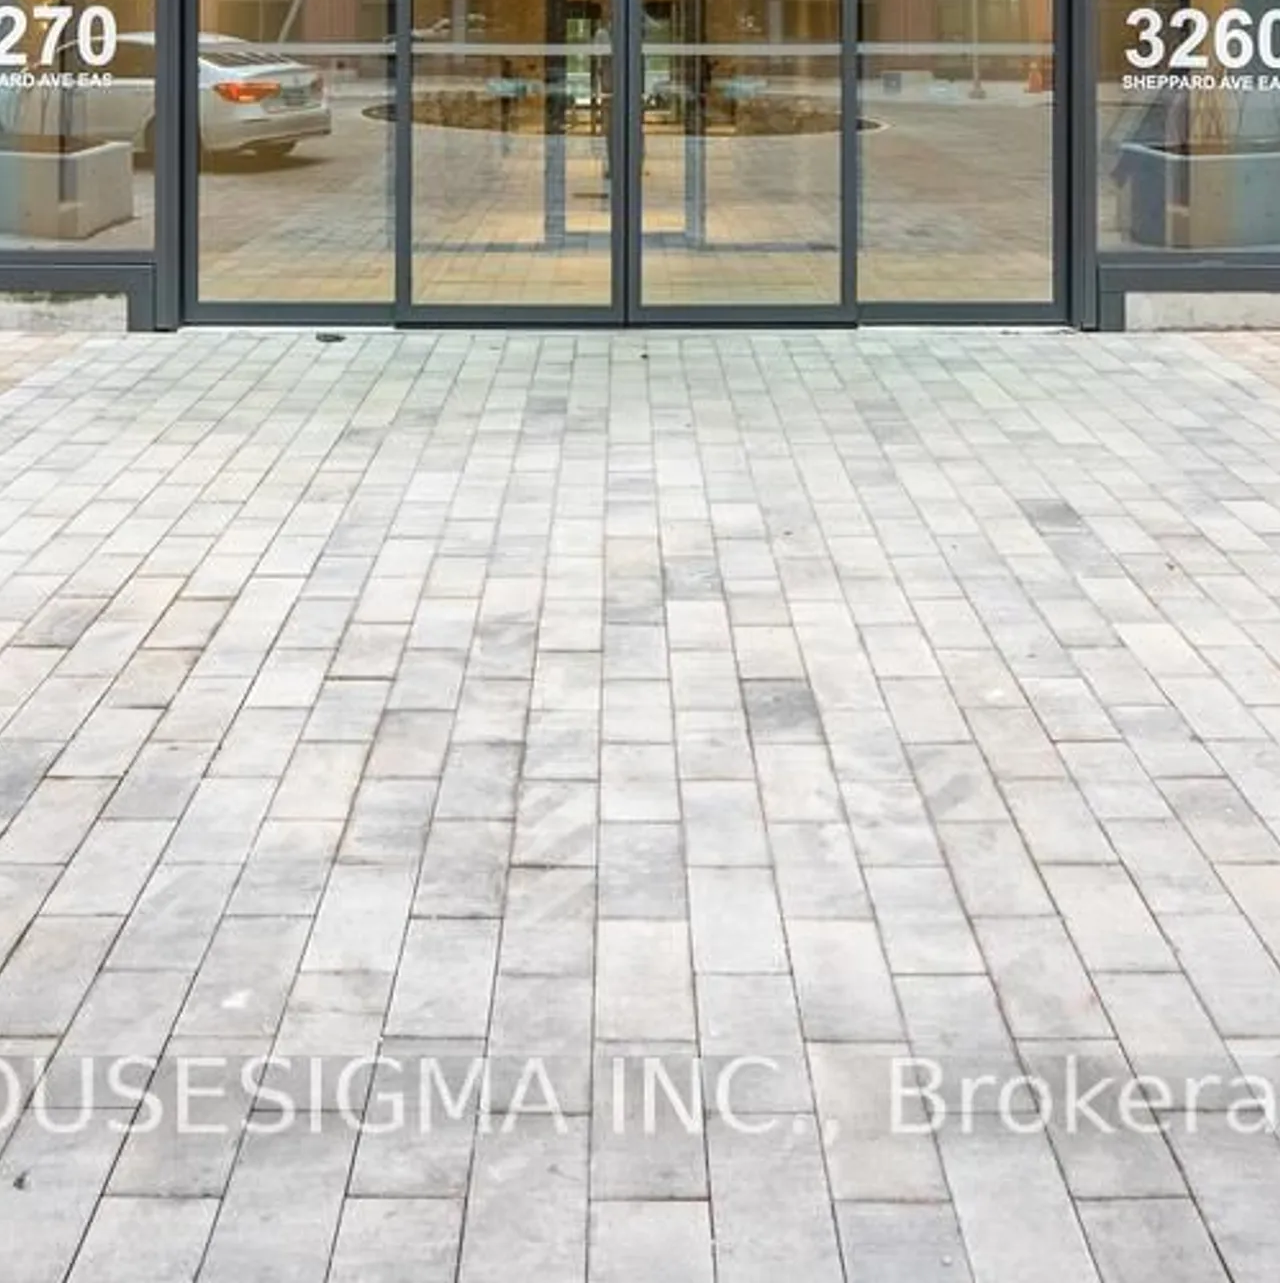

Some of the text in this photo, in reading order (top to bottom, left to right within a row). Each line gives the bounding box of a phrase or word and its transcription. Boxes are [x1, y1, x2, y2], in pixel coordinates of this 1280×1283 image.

[37, 72, 74, 88] AVE
[1122, 74, 1215, 90] SHEPPARD
[1219, 74, 1253, 91] AVE
